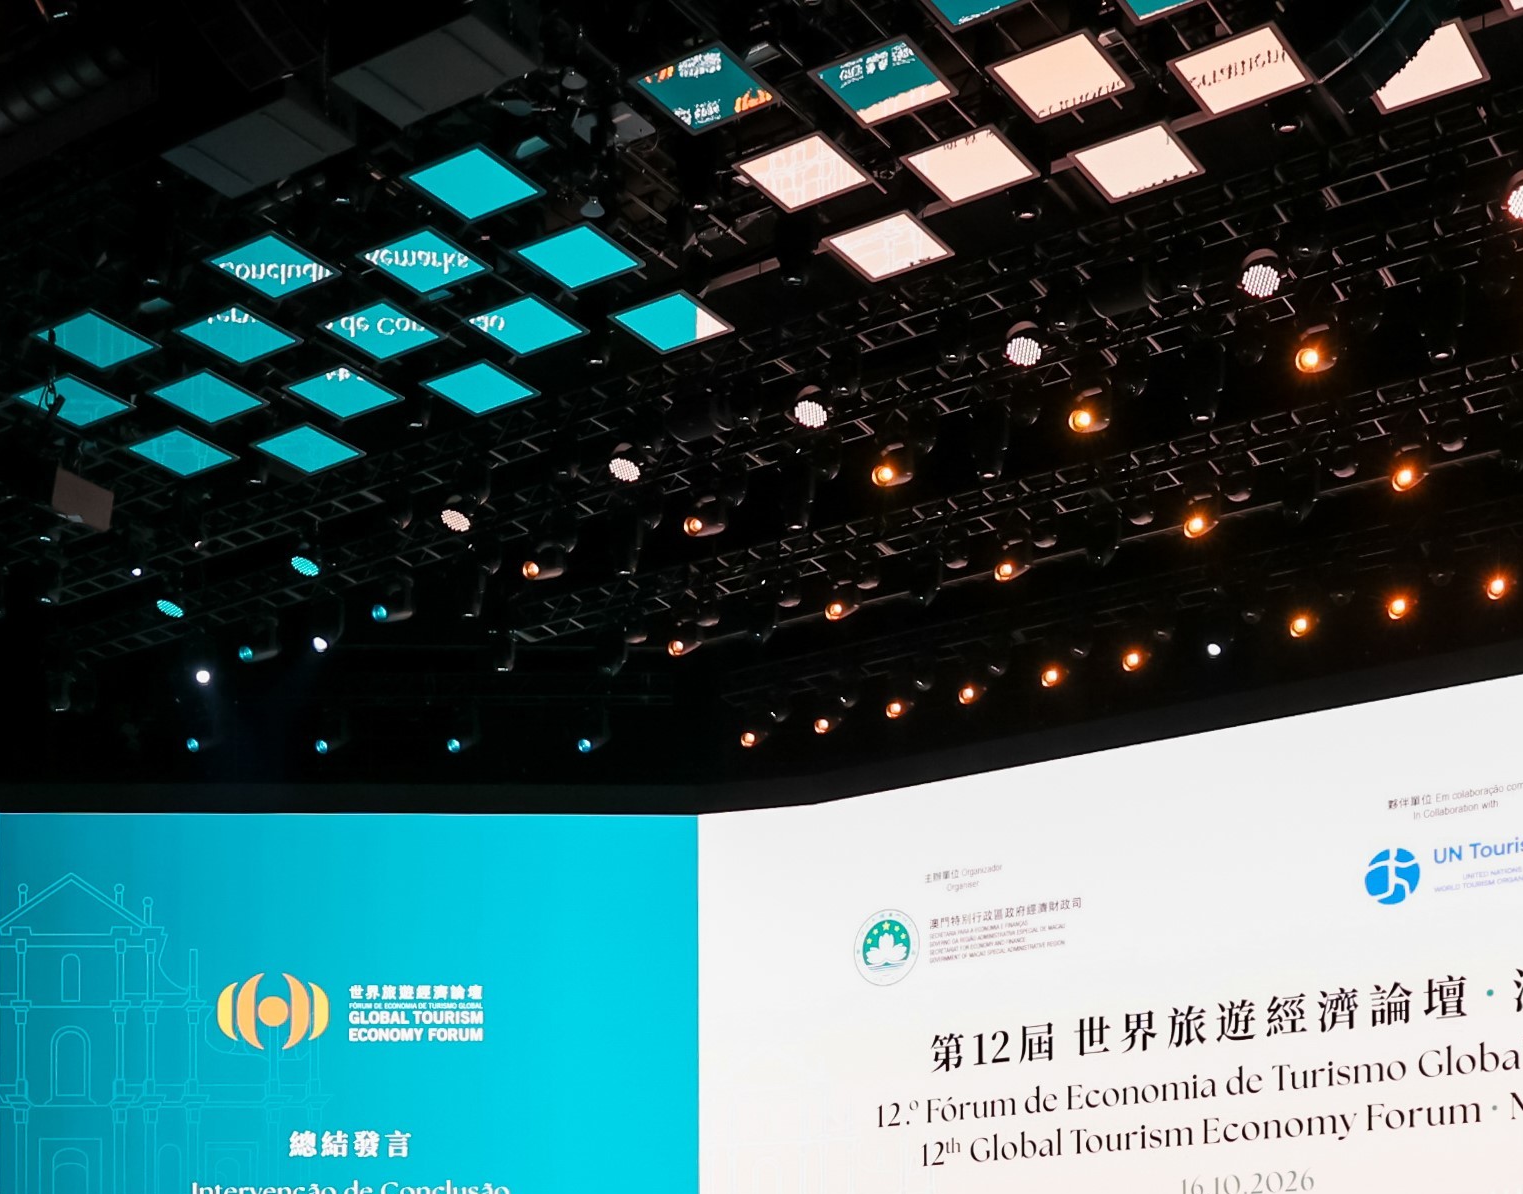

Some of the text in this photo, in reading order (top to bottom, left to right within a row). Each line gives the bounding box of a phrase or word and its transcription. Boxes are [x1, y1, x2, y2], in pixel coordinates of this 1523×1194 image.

[1436, 793, 1449, 803] Em
[1452, 784, 1504, 801] colaboração
[1424, 803, 1478, 819] Collaboration
[1482, 799, 1498, 810] with
[1434, 845, 1462, 864] UN
[349, 1010, 484, 1025] GLOBAL TOURISM
[931, 1022, 1053, 1072] 第12屆
[1074, 975, 1467, 1056] 世界旅遊經濟論壇
[349, 1027, 484, 1042] ECONOMY FORUM
[927, 1097, 1016, 1123] Fórum
[1025, 1085, 1057, 1114] de
[1067, 1074, 1216, 1110] Economia
[1226, 1065, 1262, 1095] de
[1272, 1061, 1406, 1091] Turismo
[289, 1130, 411, 1158] 總結發言
[923, 1137, 960, 1166] 12th
[970, 1128, 1062, 1162] Global
[1070, 1125, 1193, 1154] Tourism
[1203, 1113, 1357, 1144] Economy
[1367, 1103, 1481, 1131] Forum
